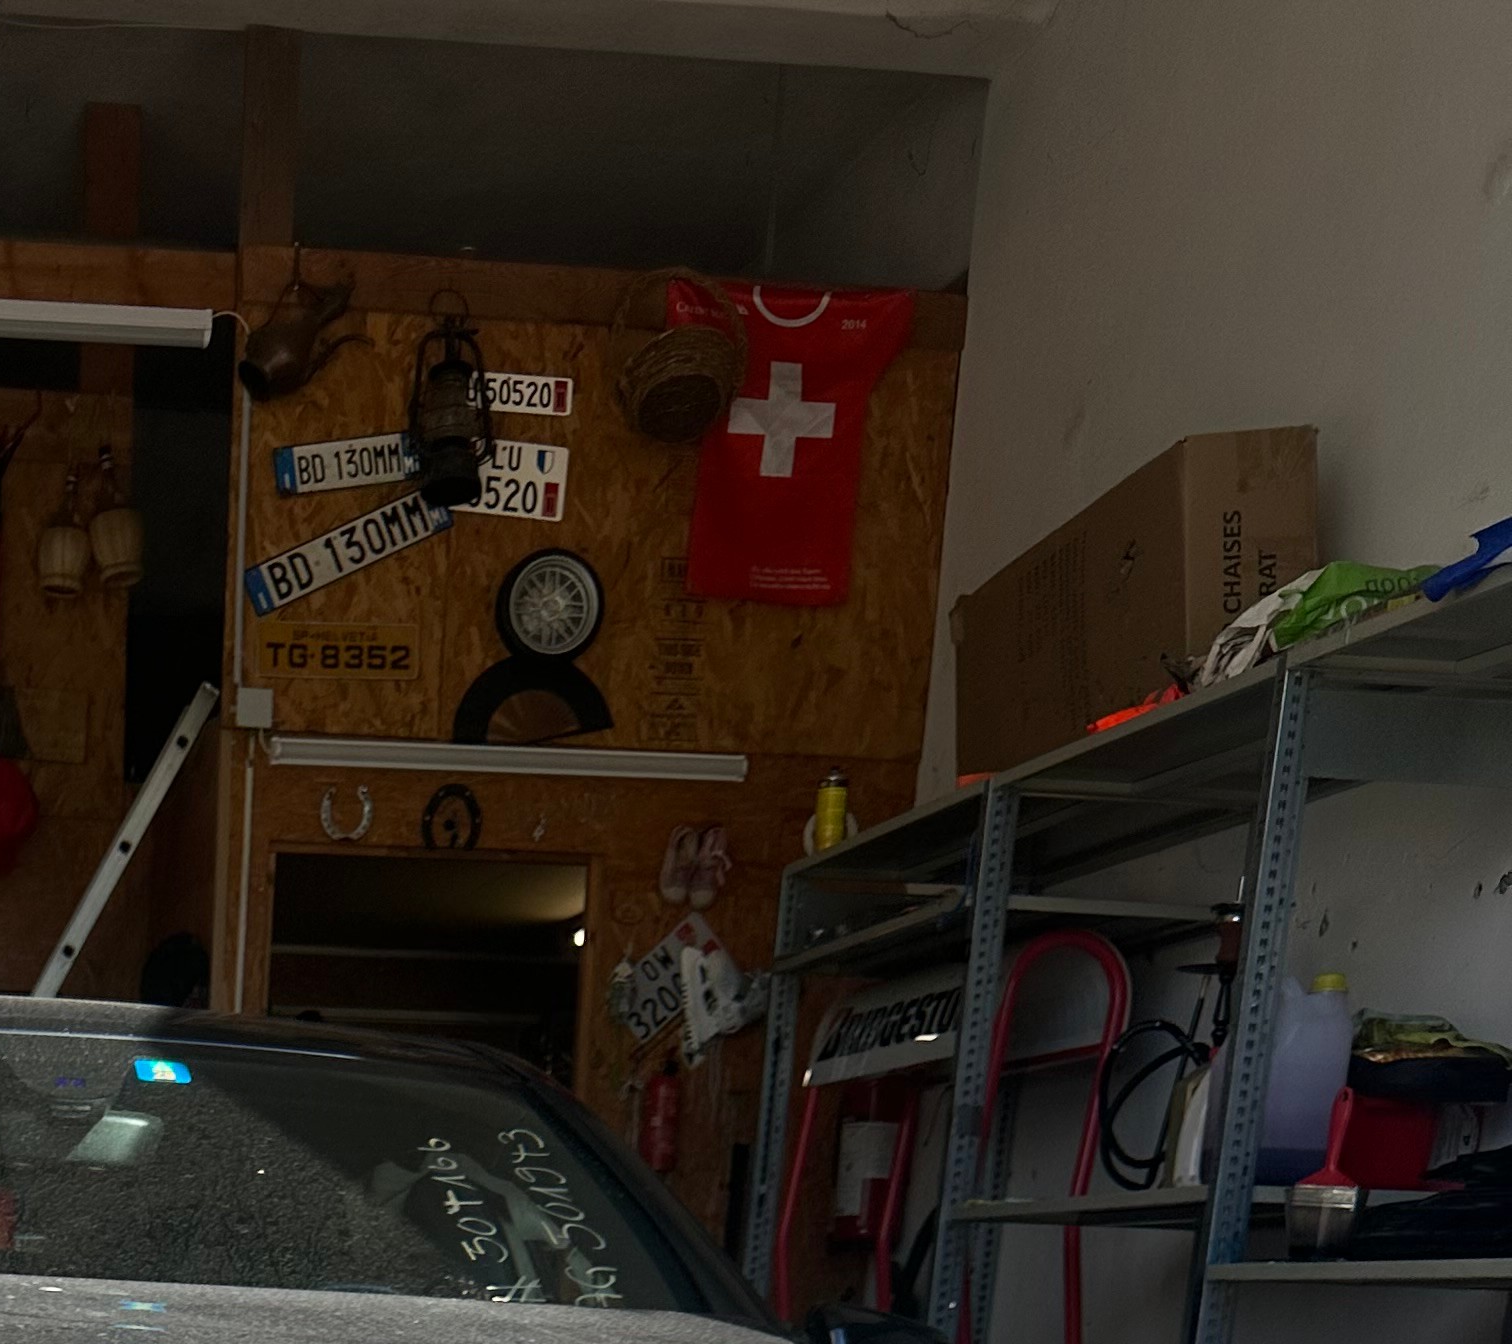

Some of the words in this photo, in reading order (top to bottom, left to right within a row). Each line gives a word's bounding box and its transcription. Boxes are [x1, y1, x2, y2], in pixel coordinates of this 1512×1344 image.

[298, 454, 325, 485] BD
[334, 443, 402, 480] 130MM
[492, 443, 523, 472] LU
[469, 477, 537, 514] 520
[268, 553, 313, 600] BD
[324, 495, 429, 573] 130MM
[1223, 510, 1242, 614] CHAISES
[641, 946, 673, 981] OW
